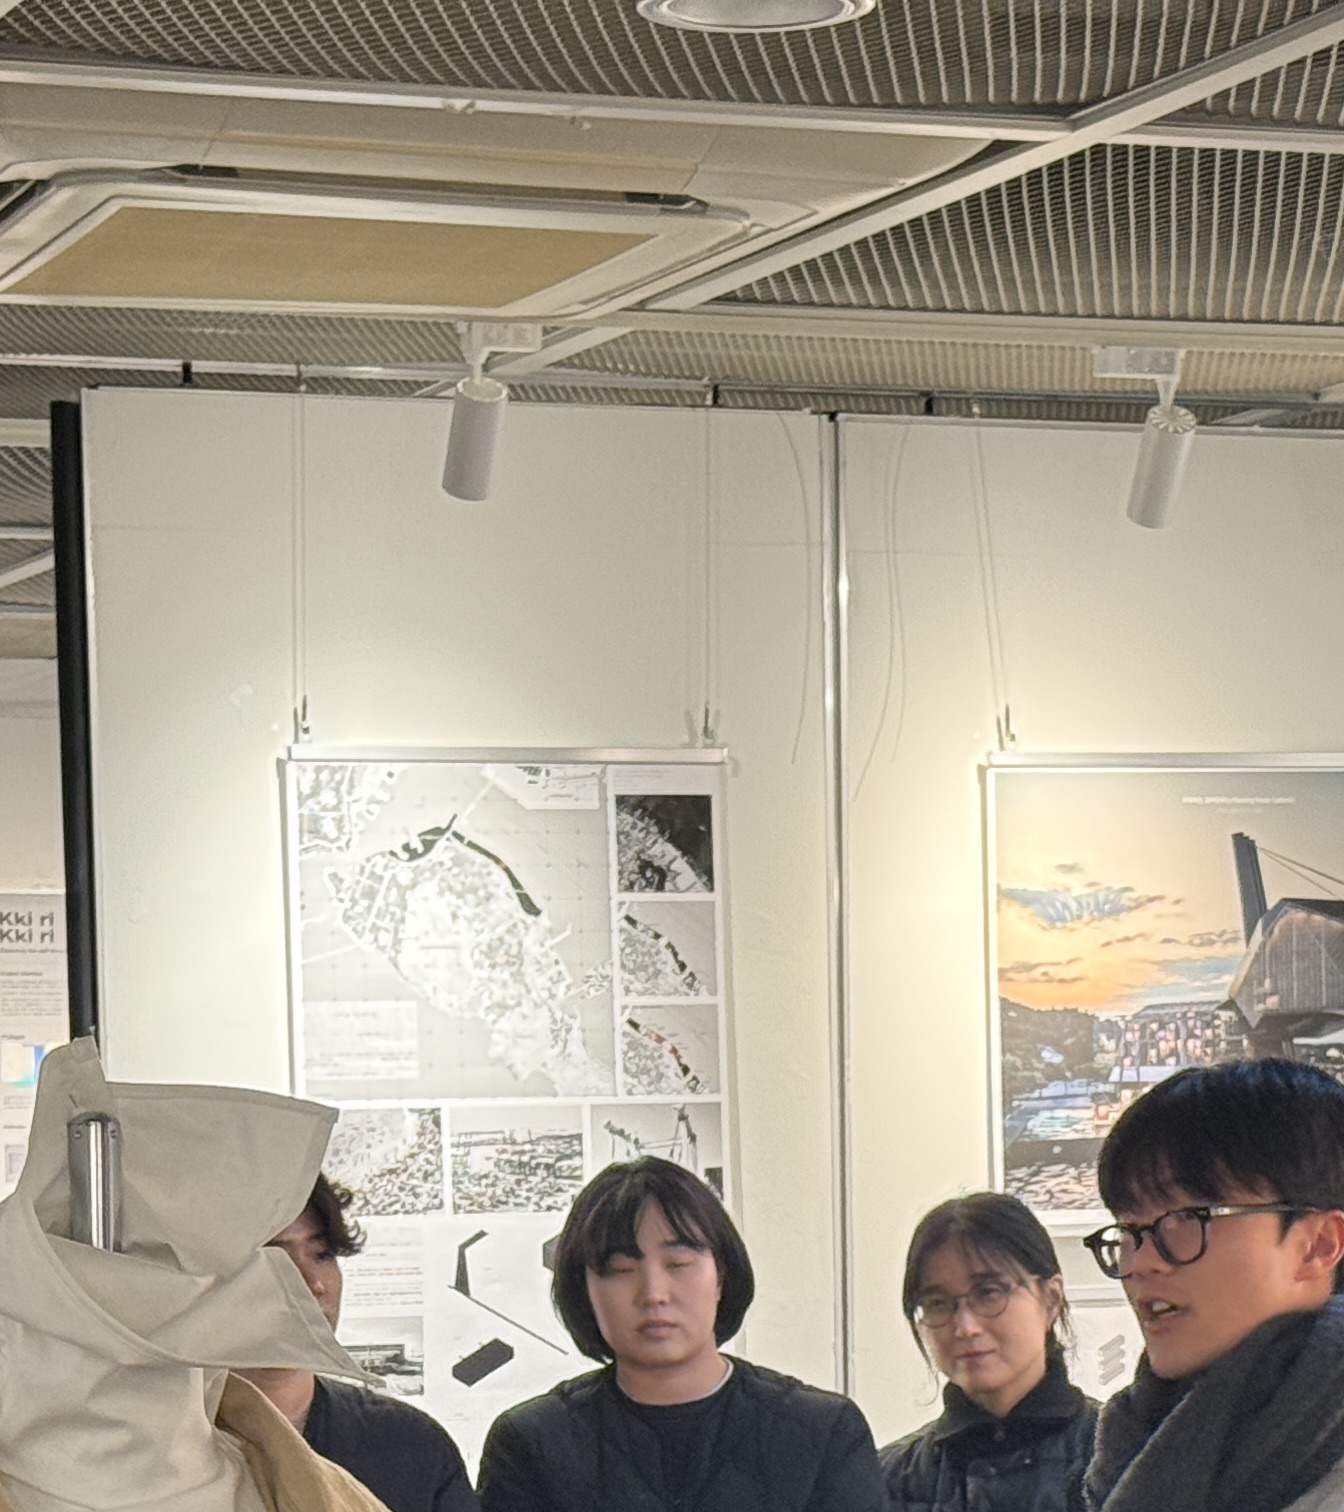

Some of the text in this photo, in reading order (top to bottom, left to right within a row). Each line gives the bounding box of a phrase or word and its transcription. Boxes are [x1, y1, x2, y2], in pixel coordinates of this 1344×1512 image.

[0, 911, 54, 927] Kki ri
[0, 928, 54, 944] Kki ri
